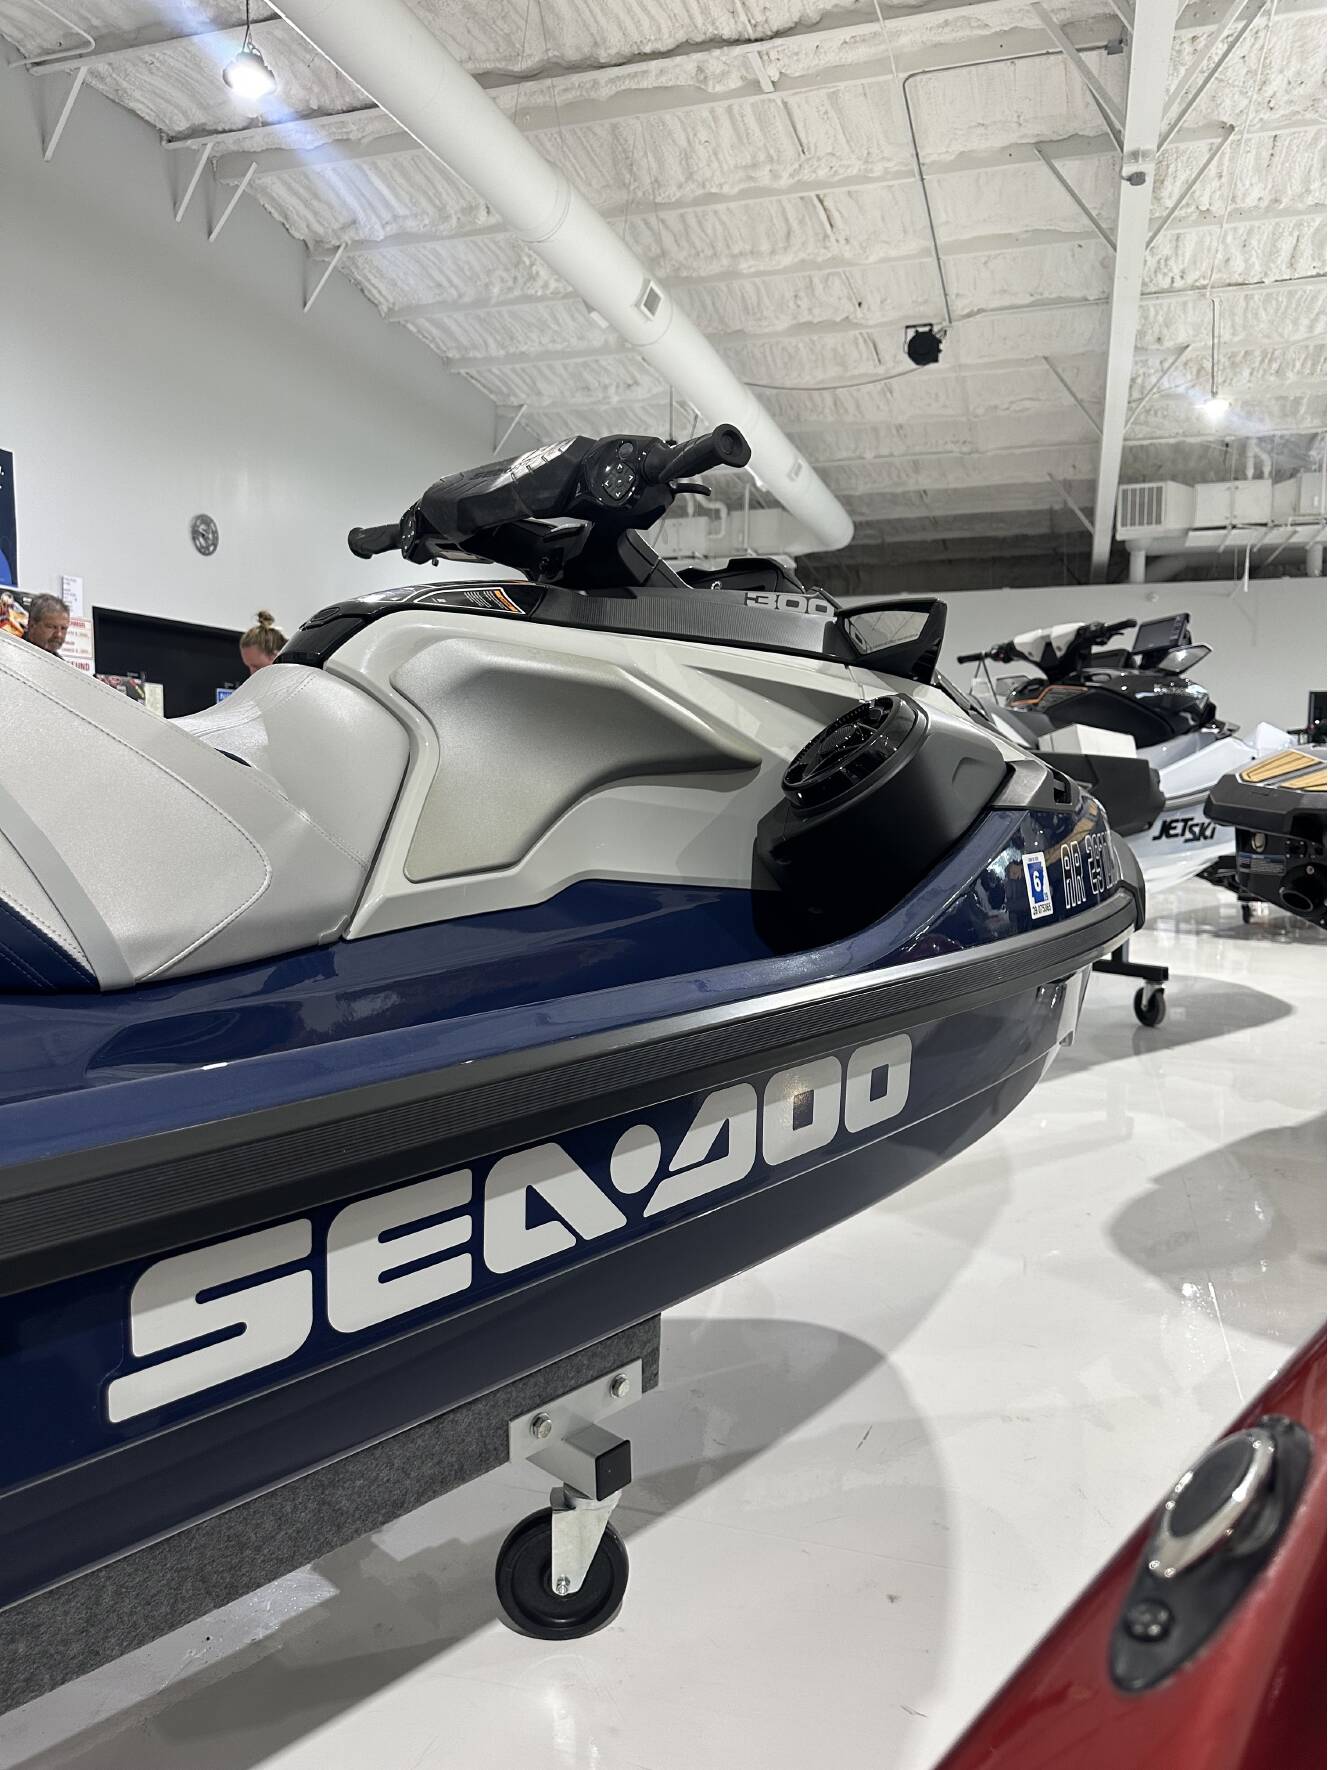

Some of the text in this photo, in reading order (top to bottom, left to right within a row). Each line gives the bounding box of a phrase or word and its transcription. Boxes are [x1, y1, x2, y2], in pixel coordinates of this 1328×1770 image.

[747, 592, 834, 617] 300
[1033, 870, 1042, 892] 6
[1060, 841, 1087, 909] AR
